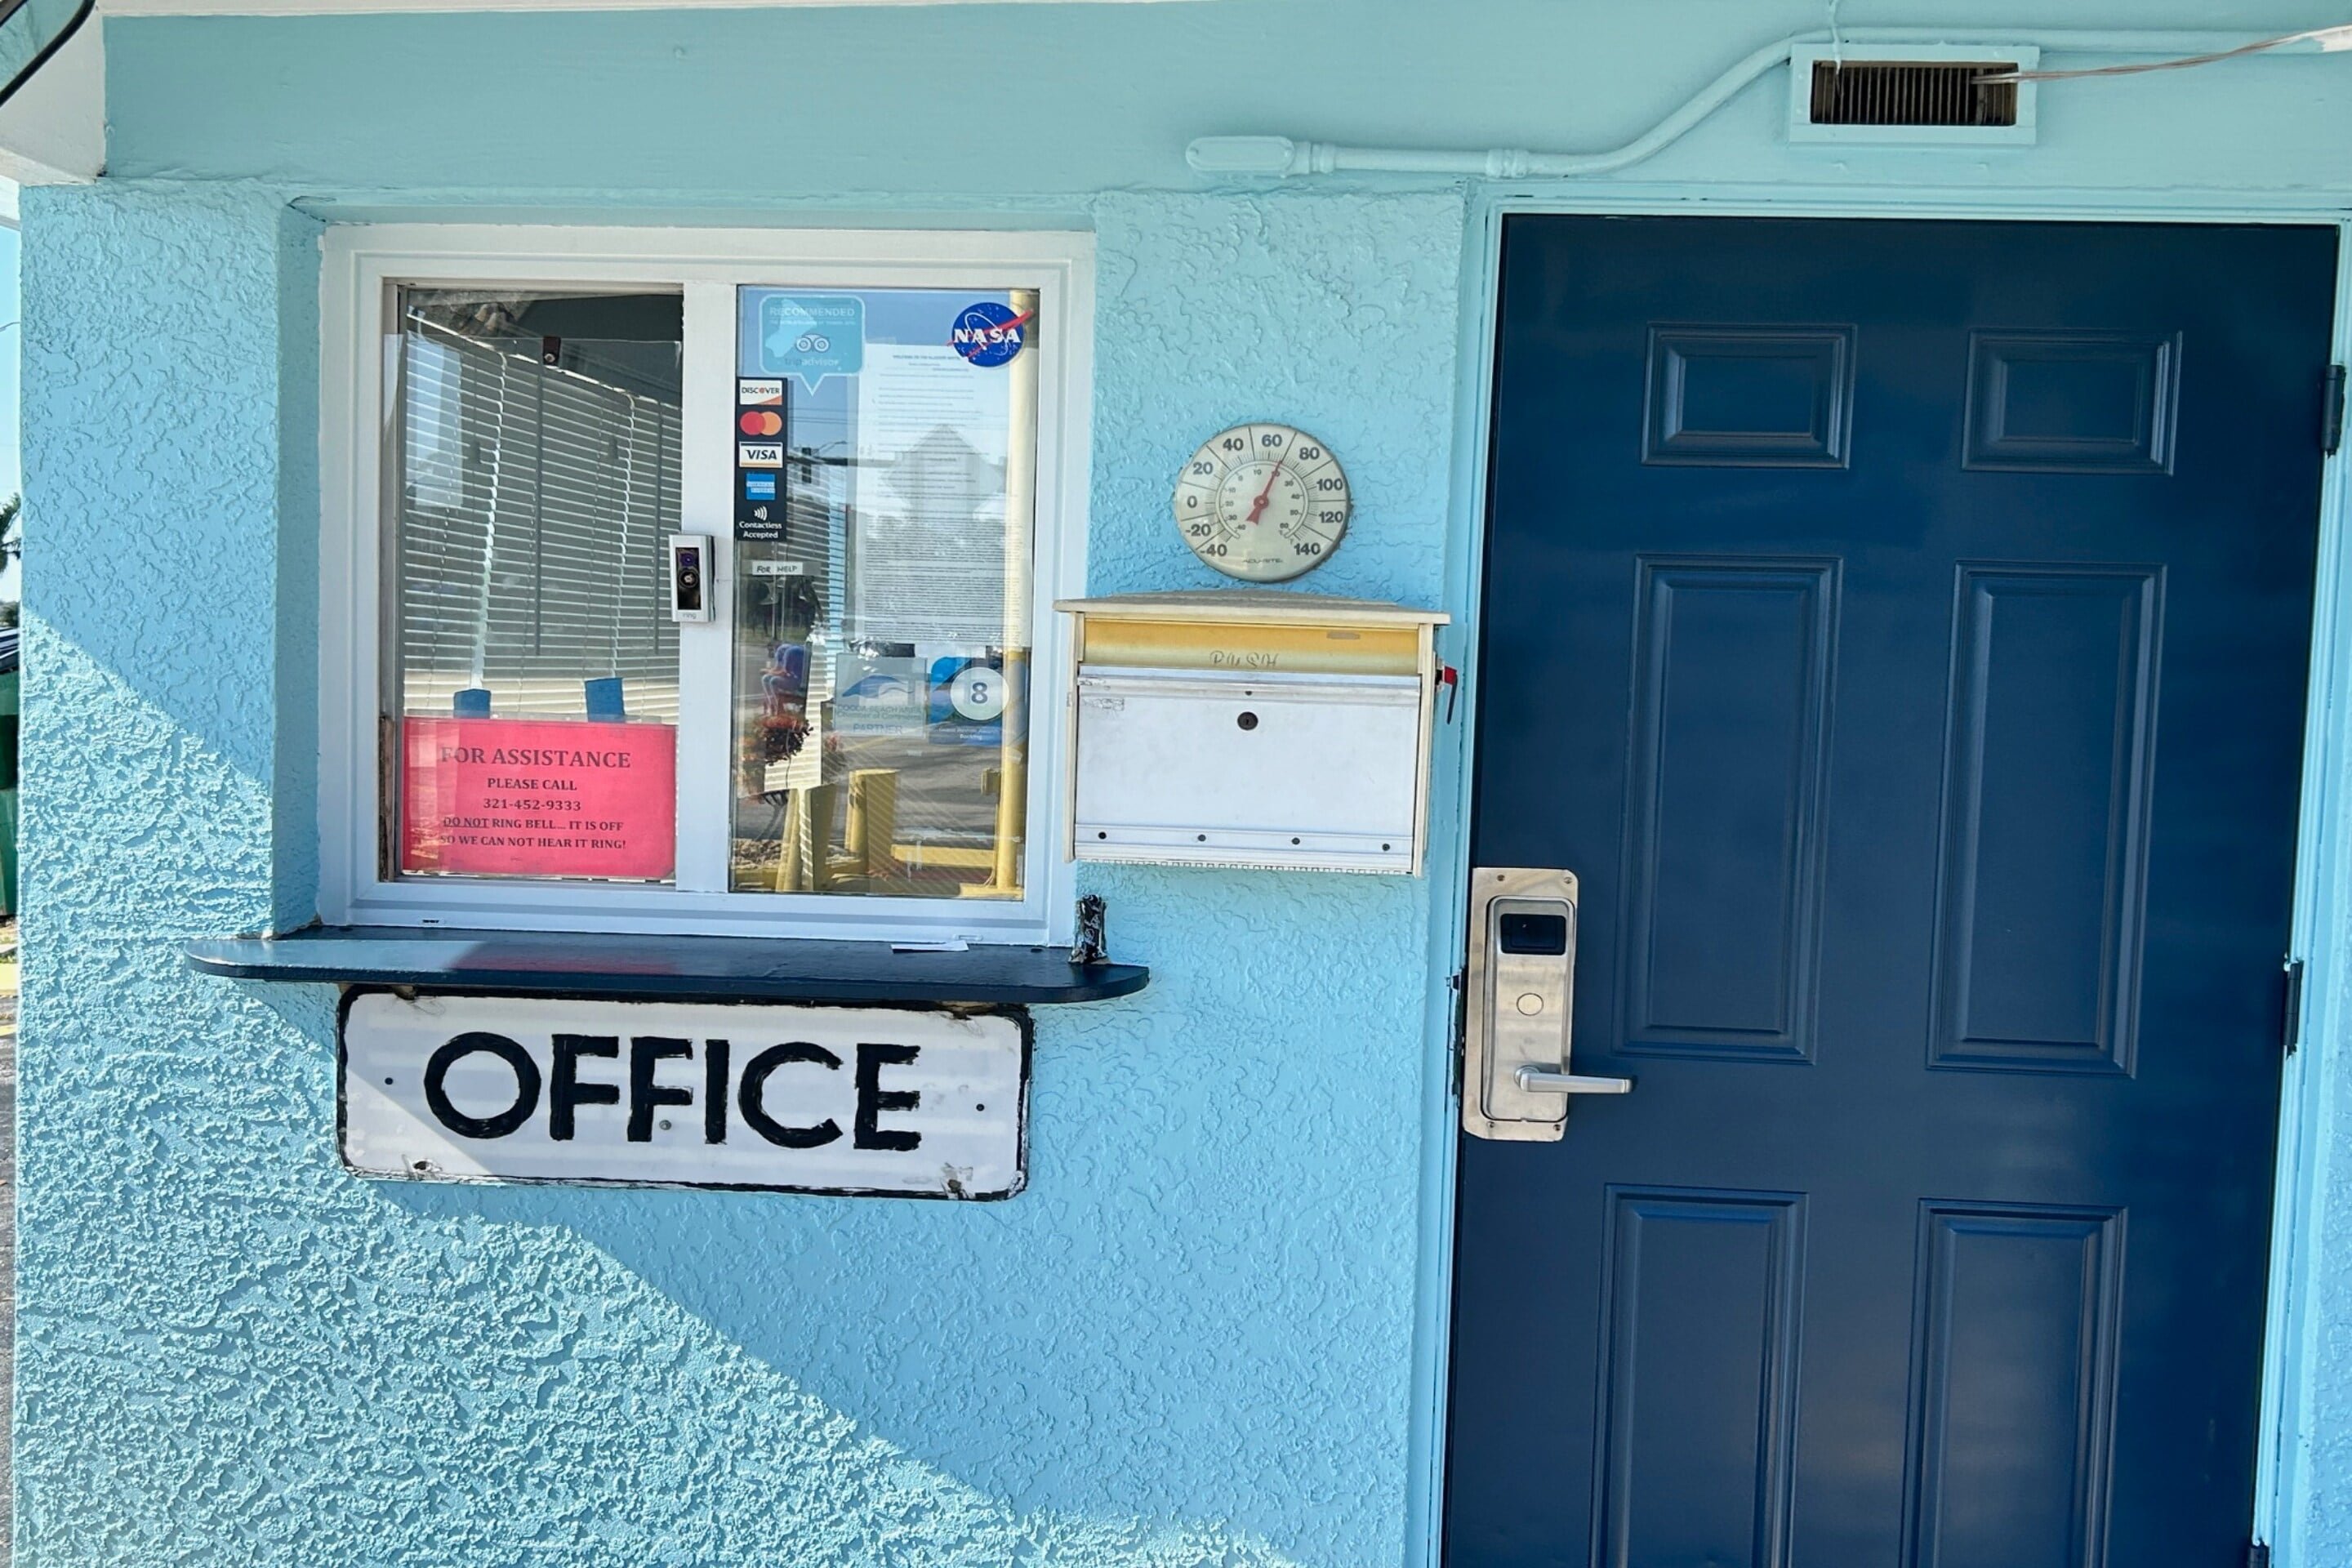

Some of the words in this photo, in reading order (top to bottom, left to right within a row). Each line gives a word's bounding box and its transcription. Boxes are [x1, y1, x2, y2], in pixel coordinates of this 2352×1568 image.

[769, 307, 855, 317] RECOMMENDED
[952, 328, 1022, 344] NASA
[1223, 438, 1244, 452] 40
[1262, 434, 1282, 448] 60
[746, 449, 777, 460] VISA
[1299, 447, 1320, 461] 80
[1192, 461, 1214, 475] 20
[1316, 479, 1343, 492] 100
[1187, 496, 1198, 508] 0
[1319, 511, 1343, 523] 120
[739, 521, 782, 529] Contactless
[743, 531, 778, 539] Accepted
[1294, 542, 1321, 555] 140
[971, 682, 988, 704] 8
[853, 724, 902, 735] PARTNER
[440, 747, 486, 764] FOR
[492, 749, 631, 768] ASSISTANCE
[487, 777, 538, 790] PLEASE
[542, 779, 577, 791] CALL
[483, 798, 581, 812] 321-452-9333
[443, 817, 461, 827] DO
[464, 817, 489, 828] NOT
[492, 818, 522, 828] RING
[569, 821, 582, 831] IT
[586, 821, 597, 831] IS
[599, 822, 624, 831] OFF
[441, 835, 455, 844] SO
[458, 835, 478, 845] WE
[481, 836, 505, 846] CAN
[508, 837, 535, 847] NOT
[537, 838, 572, 848] HEAR
[575, 839, 588, 848] IT
[591, 839, 626, 849] RING!
[424, 1031, 922, 1151] OFFICE
